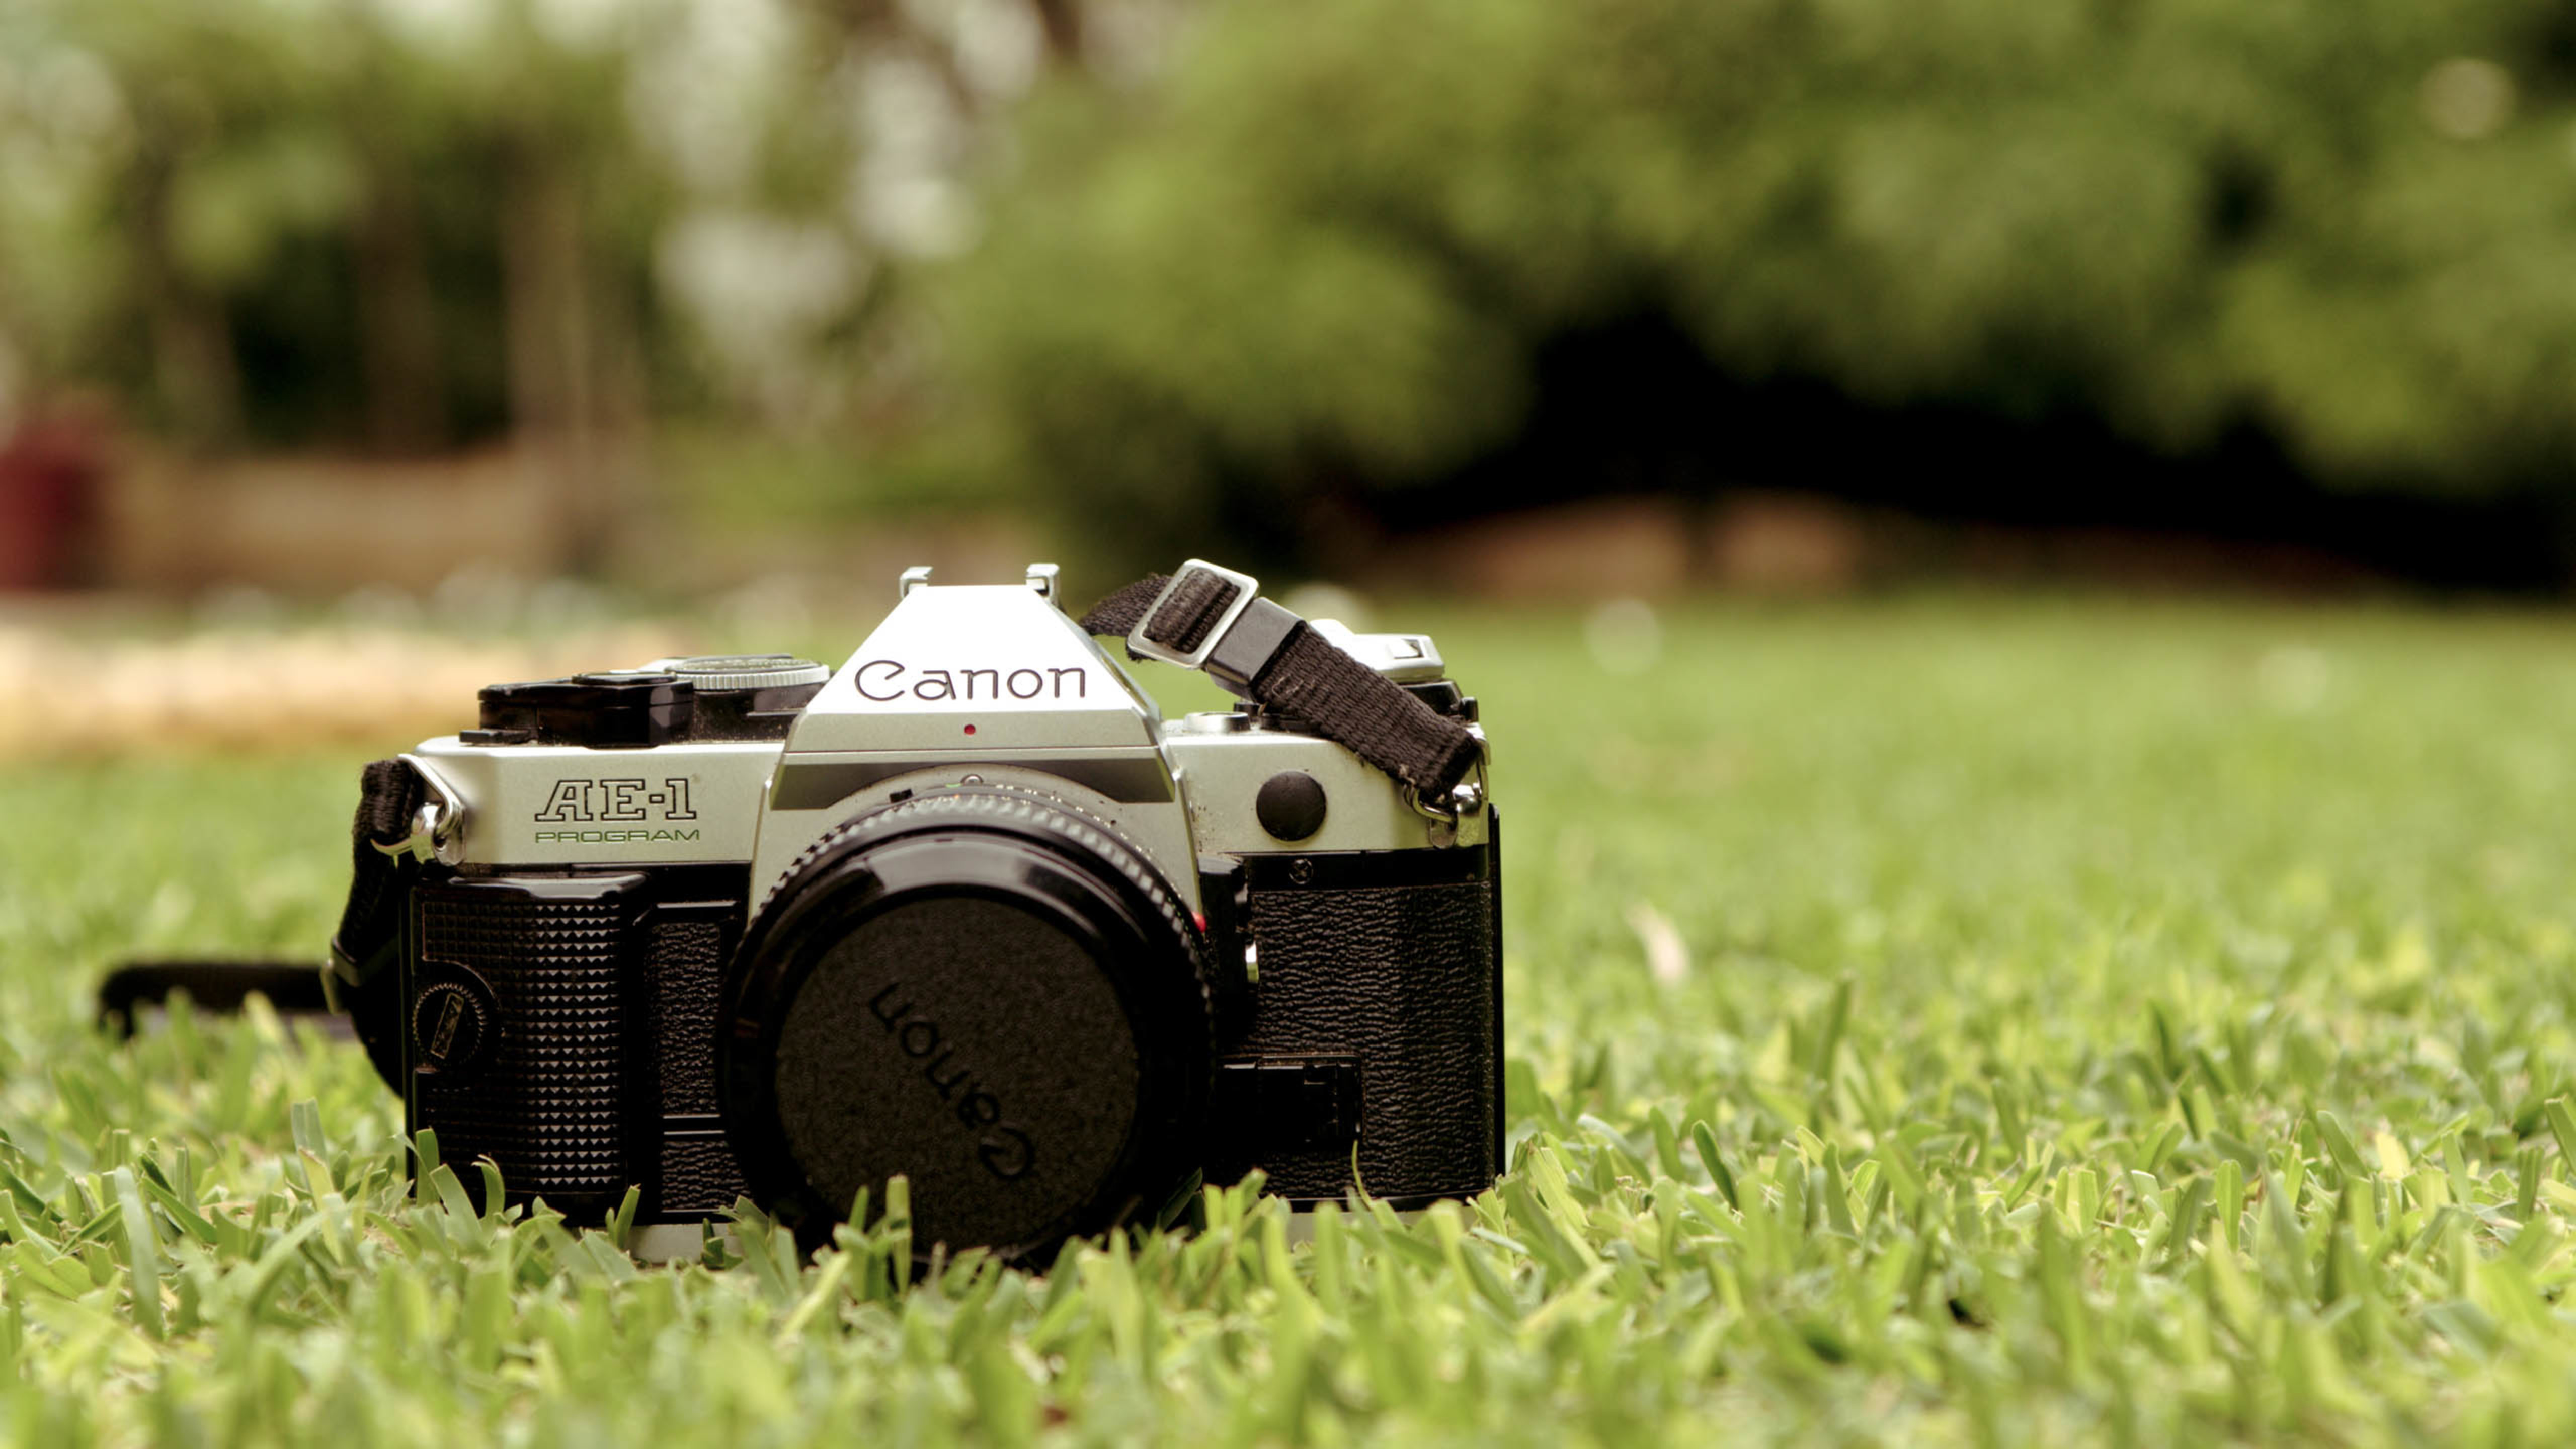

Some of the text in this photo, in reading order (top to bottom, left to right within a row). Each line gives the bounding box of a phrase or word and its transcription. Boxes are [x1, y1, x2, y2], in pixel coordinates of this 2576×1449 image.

[855, 660, 1085, 701] Canon
[535, 778, 697, 822] AE-1
[535, 829, 700, 843] PROGRAM
[870, 982, 1034, 1179] Canon
